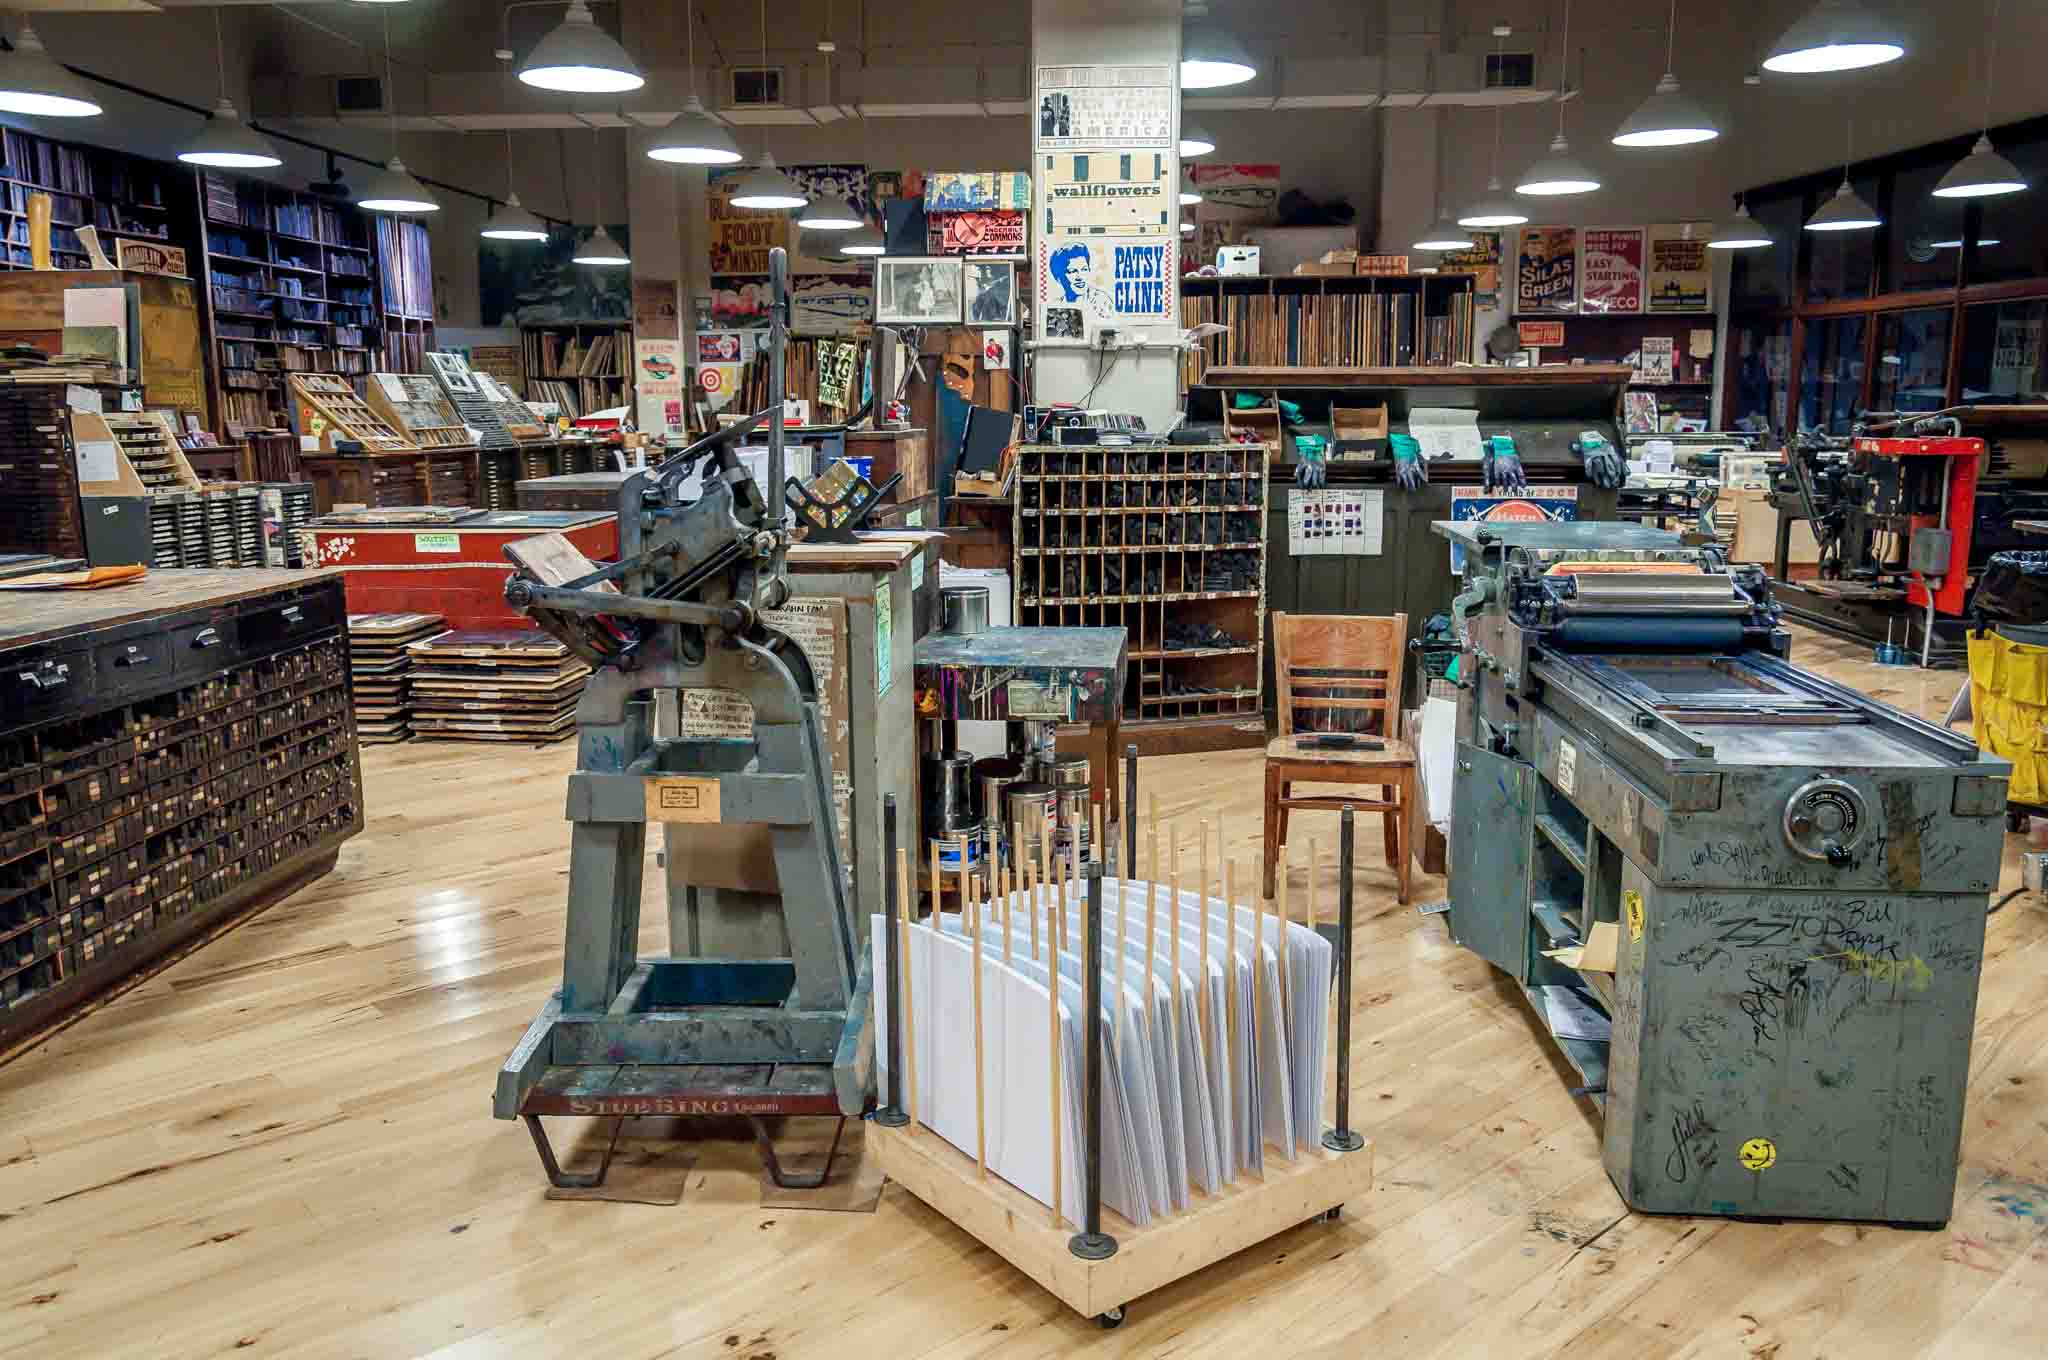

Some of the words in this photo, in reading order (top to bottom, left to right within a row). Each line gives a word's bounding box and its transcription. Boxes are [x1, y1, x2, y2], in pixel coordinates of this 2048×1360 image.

[1054, 185, 1161, 196] wallflowers
[984, 233, 1023, 241] COMMONS
[1115, 246, 1163, 278] PATSY
[1585, 258, 1614, 269] EASY
[1521, 260, 1573, 283] SILAS
[1585, 270, 1638, 281] STARTING
[1521, 275, 1573, 298] GREEN
[1115, 281, 1163, 312] CLINE
